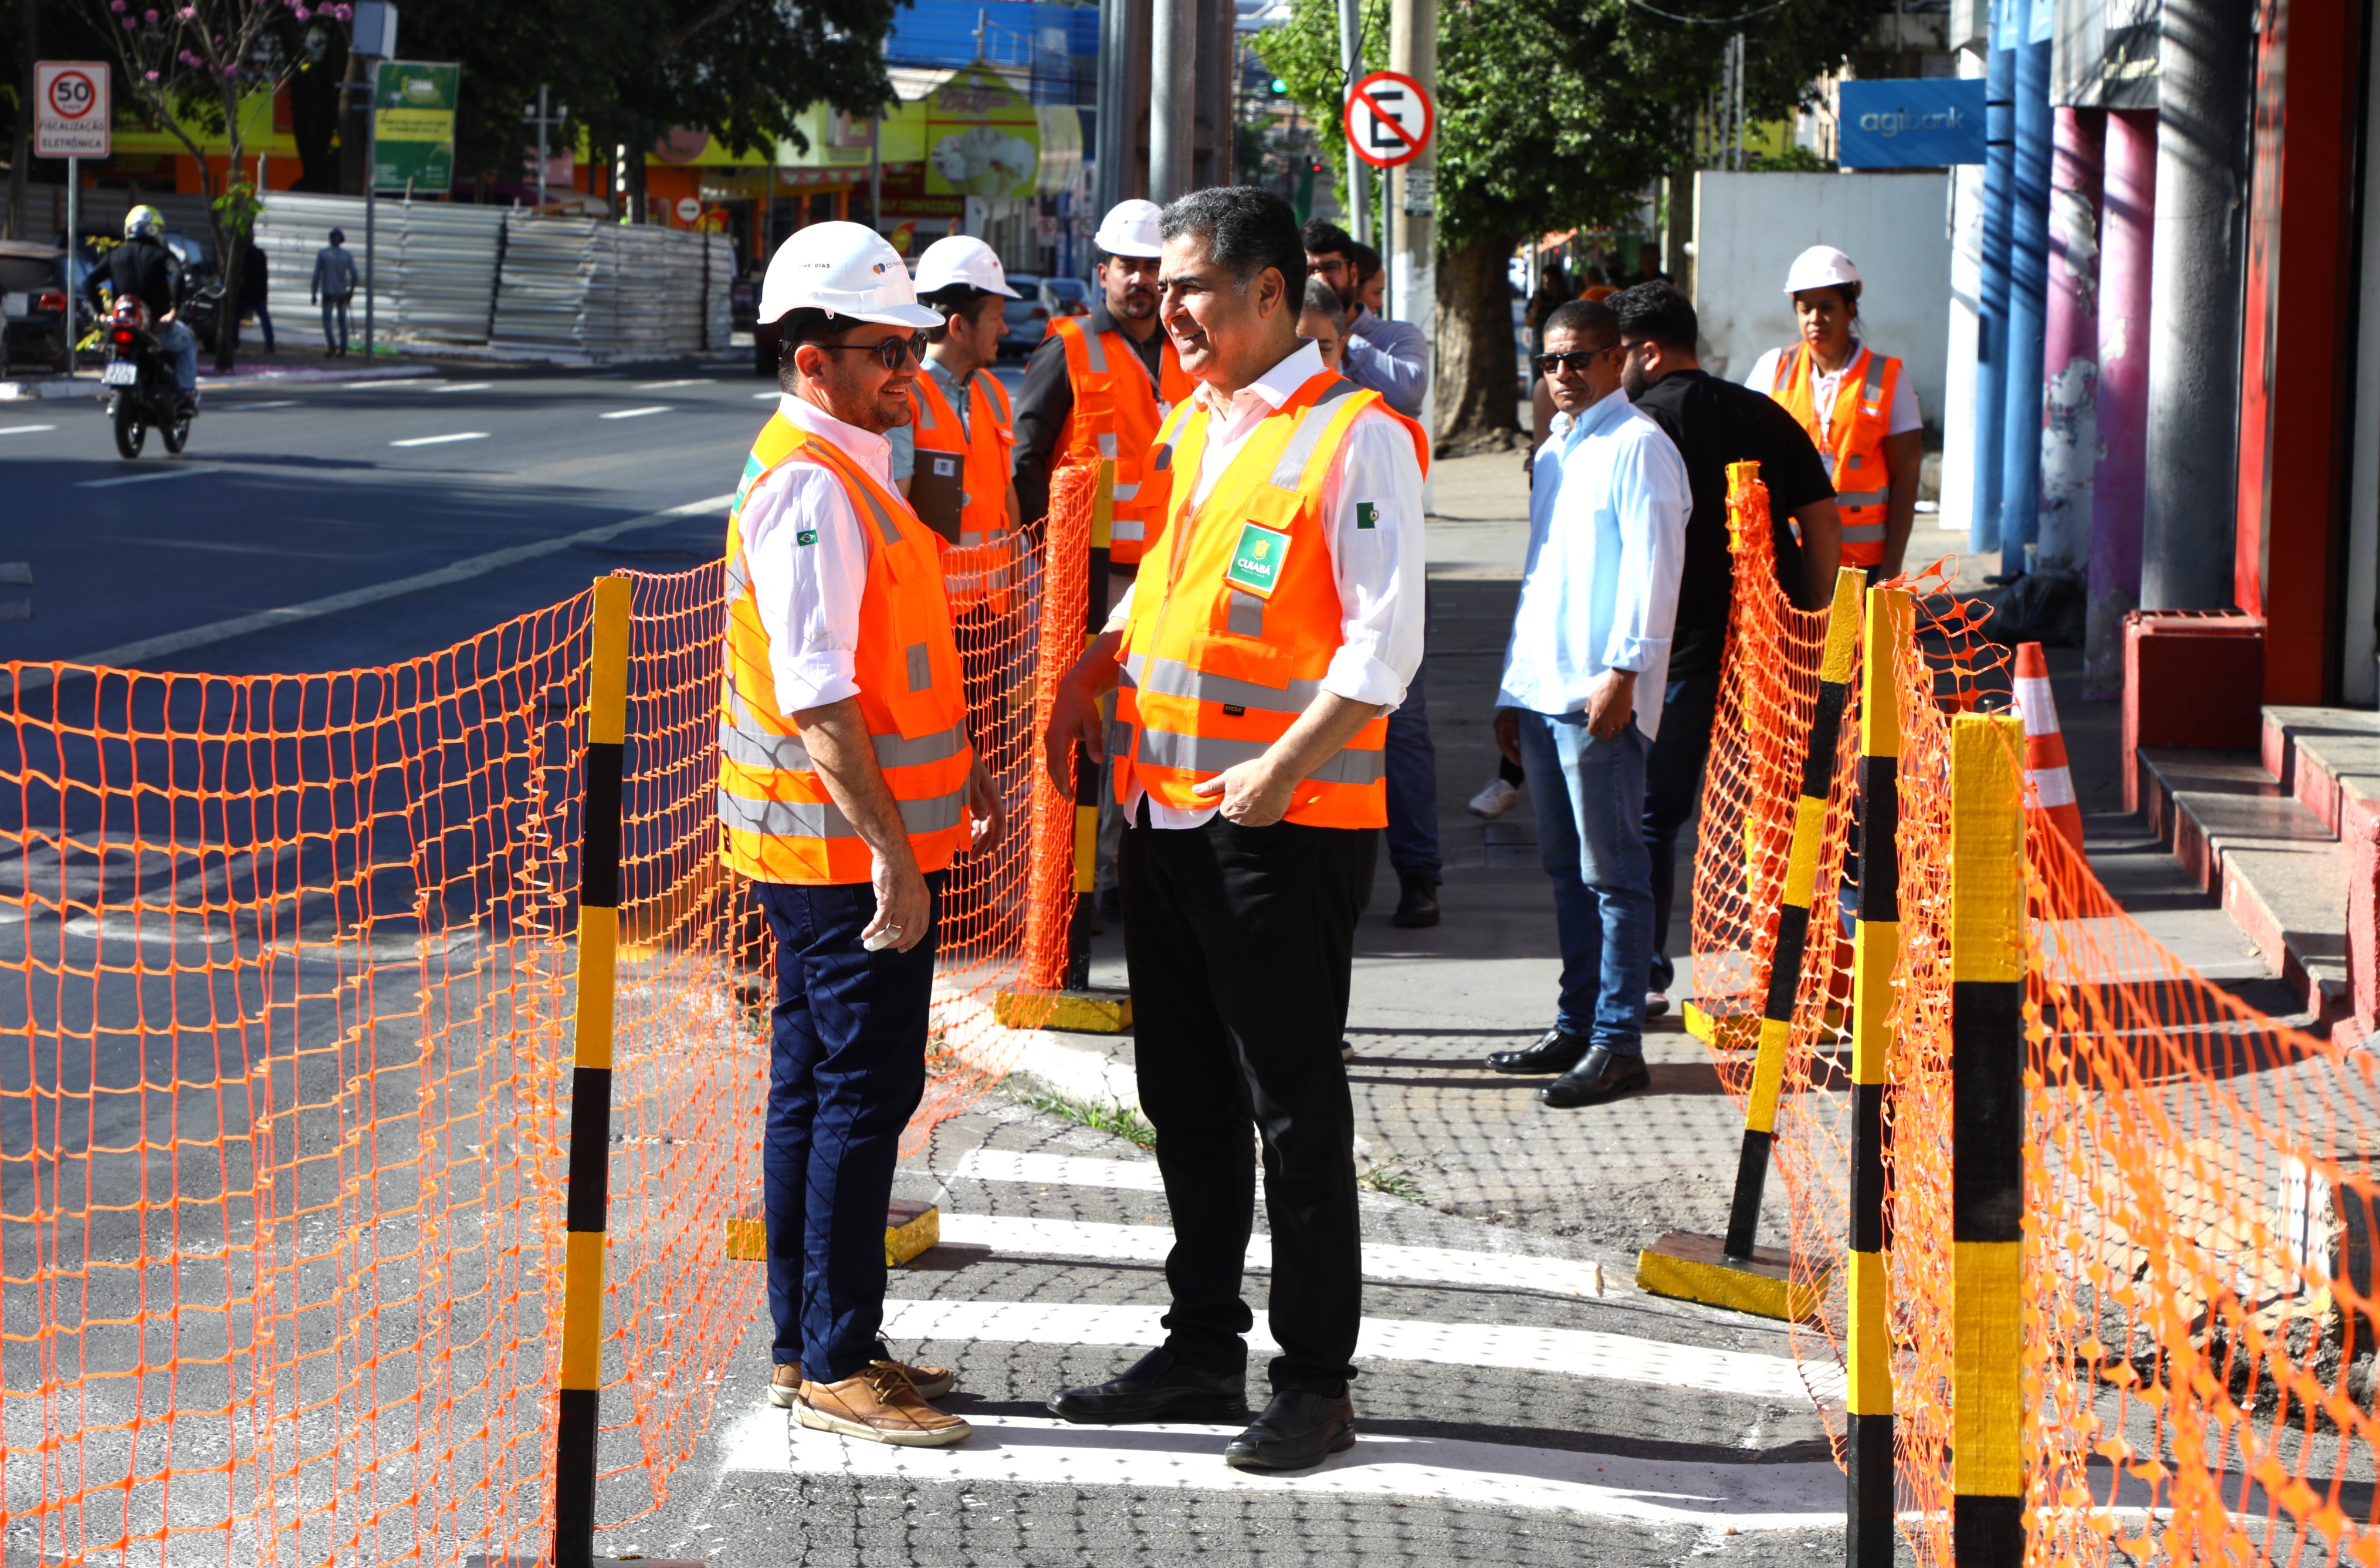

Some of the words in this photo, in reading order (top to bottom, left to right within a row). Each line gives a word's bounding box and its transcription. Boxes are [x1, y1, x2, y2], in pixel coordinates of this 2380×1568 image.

[57, 82, 89, 102] 50
[39, 120, 104, 132] FISCALIZAÇÃO
[1369, 91, 1406, 147] E
[1860, 106, 1964, 138] agibank
[42, 136, 101, 148] ELETRÔNICA
[1238, 558, 1271, 576] CUIABÁ
[1241, 568, 1265, 578] PREFEITURA
